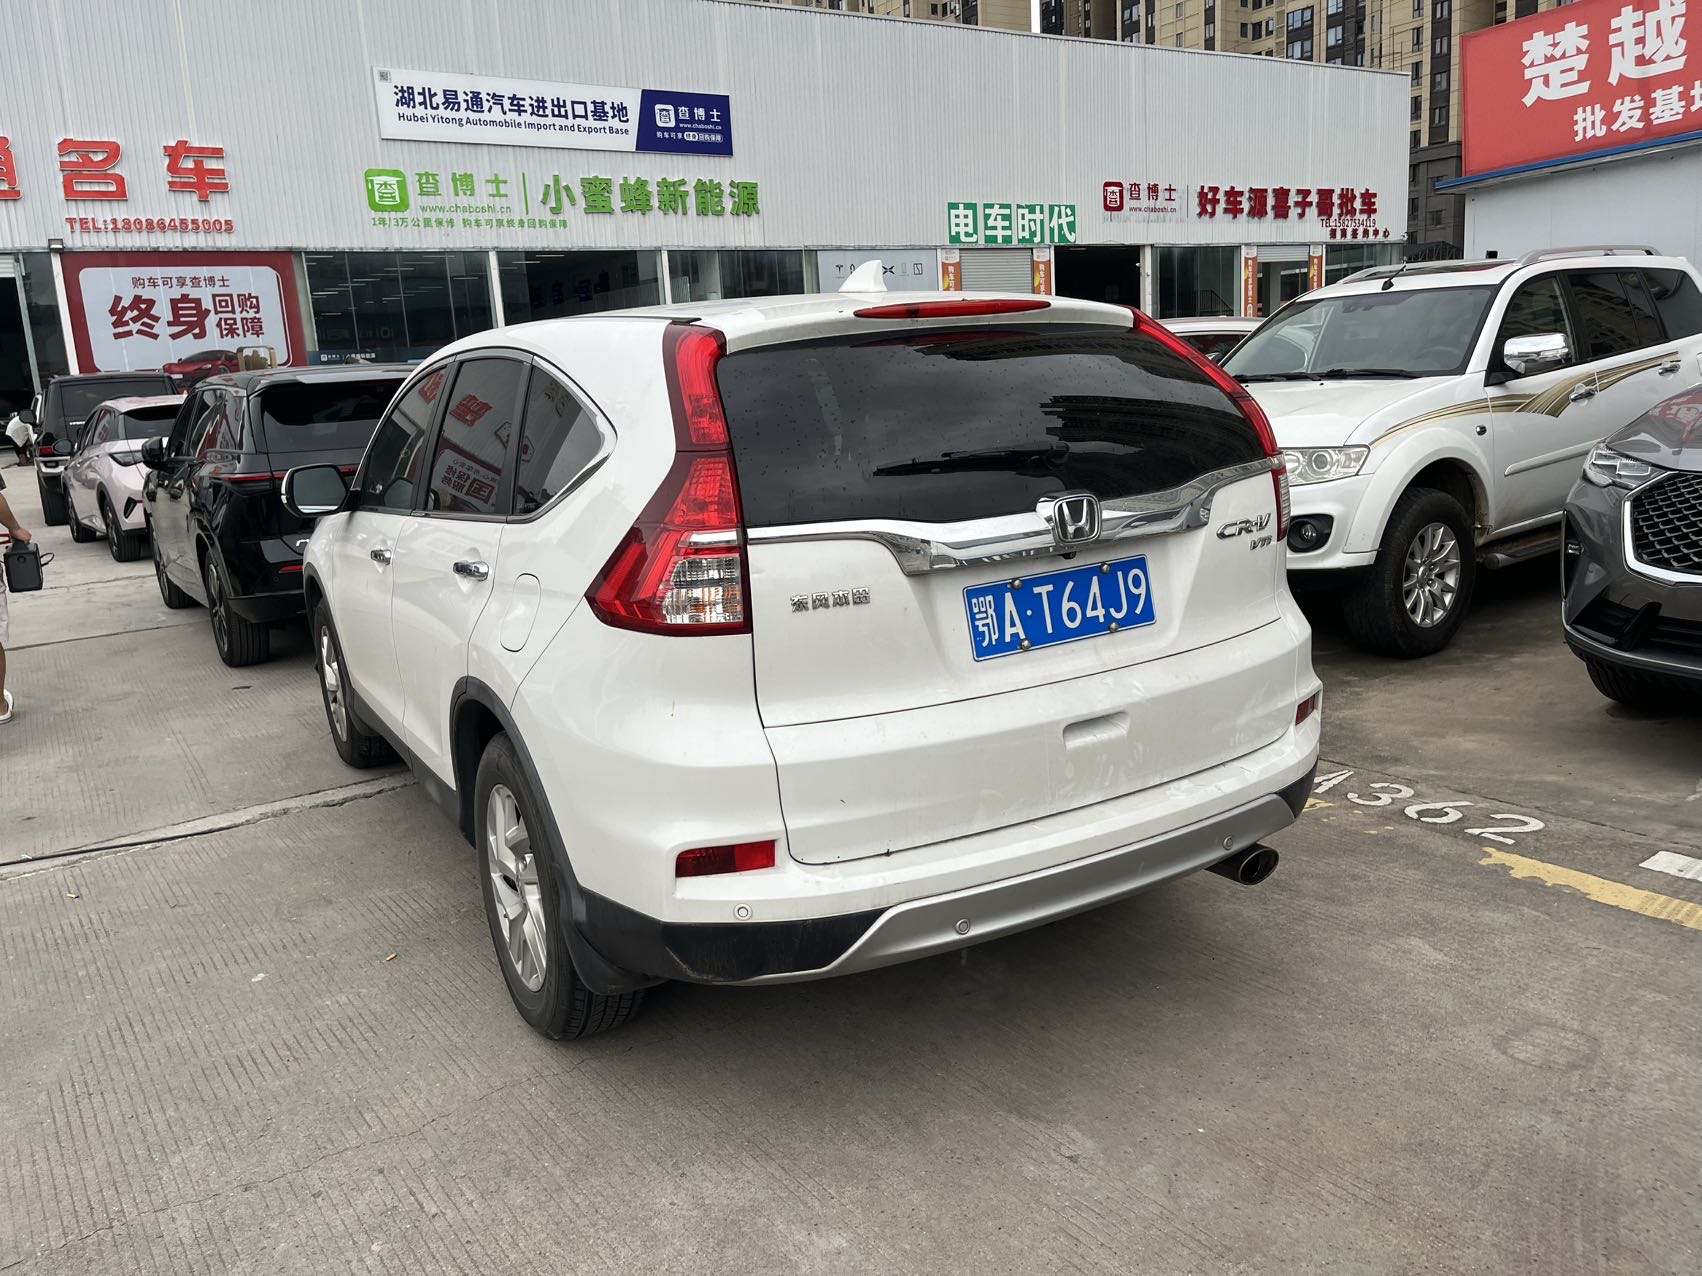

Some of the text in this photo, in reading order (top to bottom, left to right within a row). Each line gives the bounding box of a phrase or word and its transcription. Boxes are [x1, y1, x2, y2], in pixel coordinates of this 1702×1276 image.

[1521, 0, 1687, 108] 楚越
[393, 84, 630, 123] 湖北易通汽车进出口基地
[678, 106, 721, 122] 查博士
[398, 112, 629, 136] Hubei Yitong Automobile Import and Export Base
[415, 171, 509, 198] 查博士
[540, 174, 761, 217] 小蜜蜂新能源
[1129, 182, 1177, 202] 查博士
[418, 202, 512, 214] www.chaboshi.cn
[1129, 205, 1177, 213] www.chaboshi.cn
[1197, 185, 1378, 220] 好车源喜子哥批车
[65, 217, 236, 233] TEL:18086455005
[949, 203, 1077, 244] 电车时代
[132, 275, 231, 289] 购车可享查博士
[211, 292, 261, 316] 回购
[108, 293, 212, 341] 终身
[215, 315, 265, 339] 保障
[790, 587, 871, 612] 东风本田
[971, 568, 1147, 648] 鄂A·T64J9
